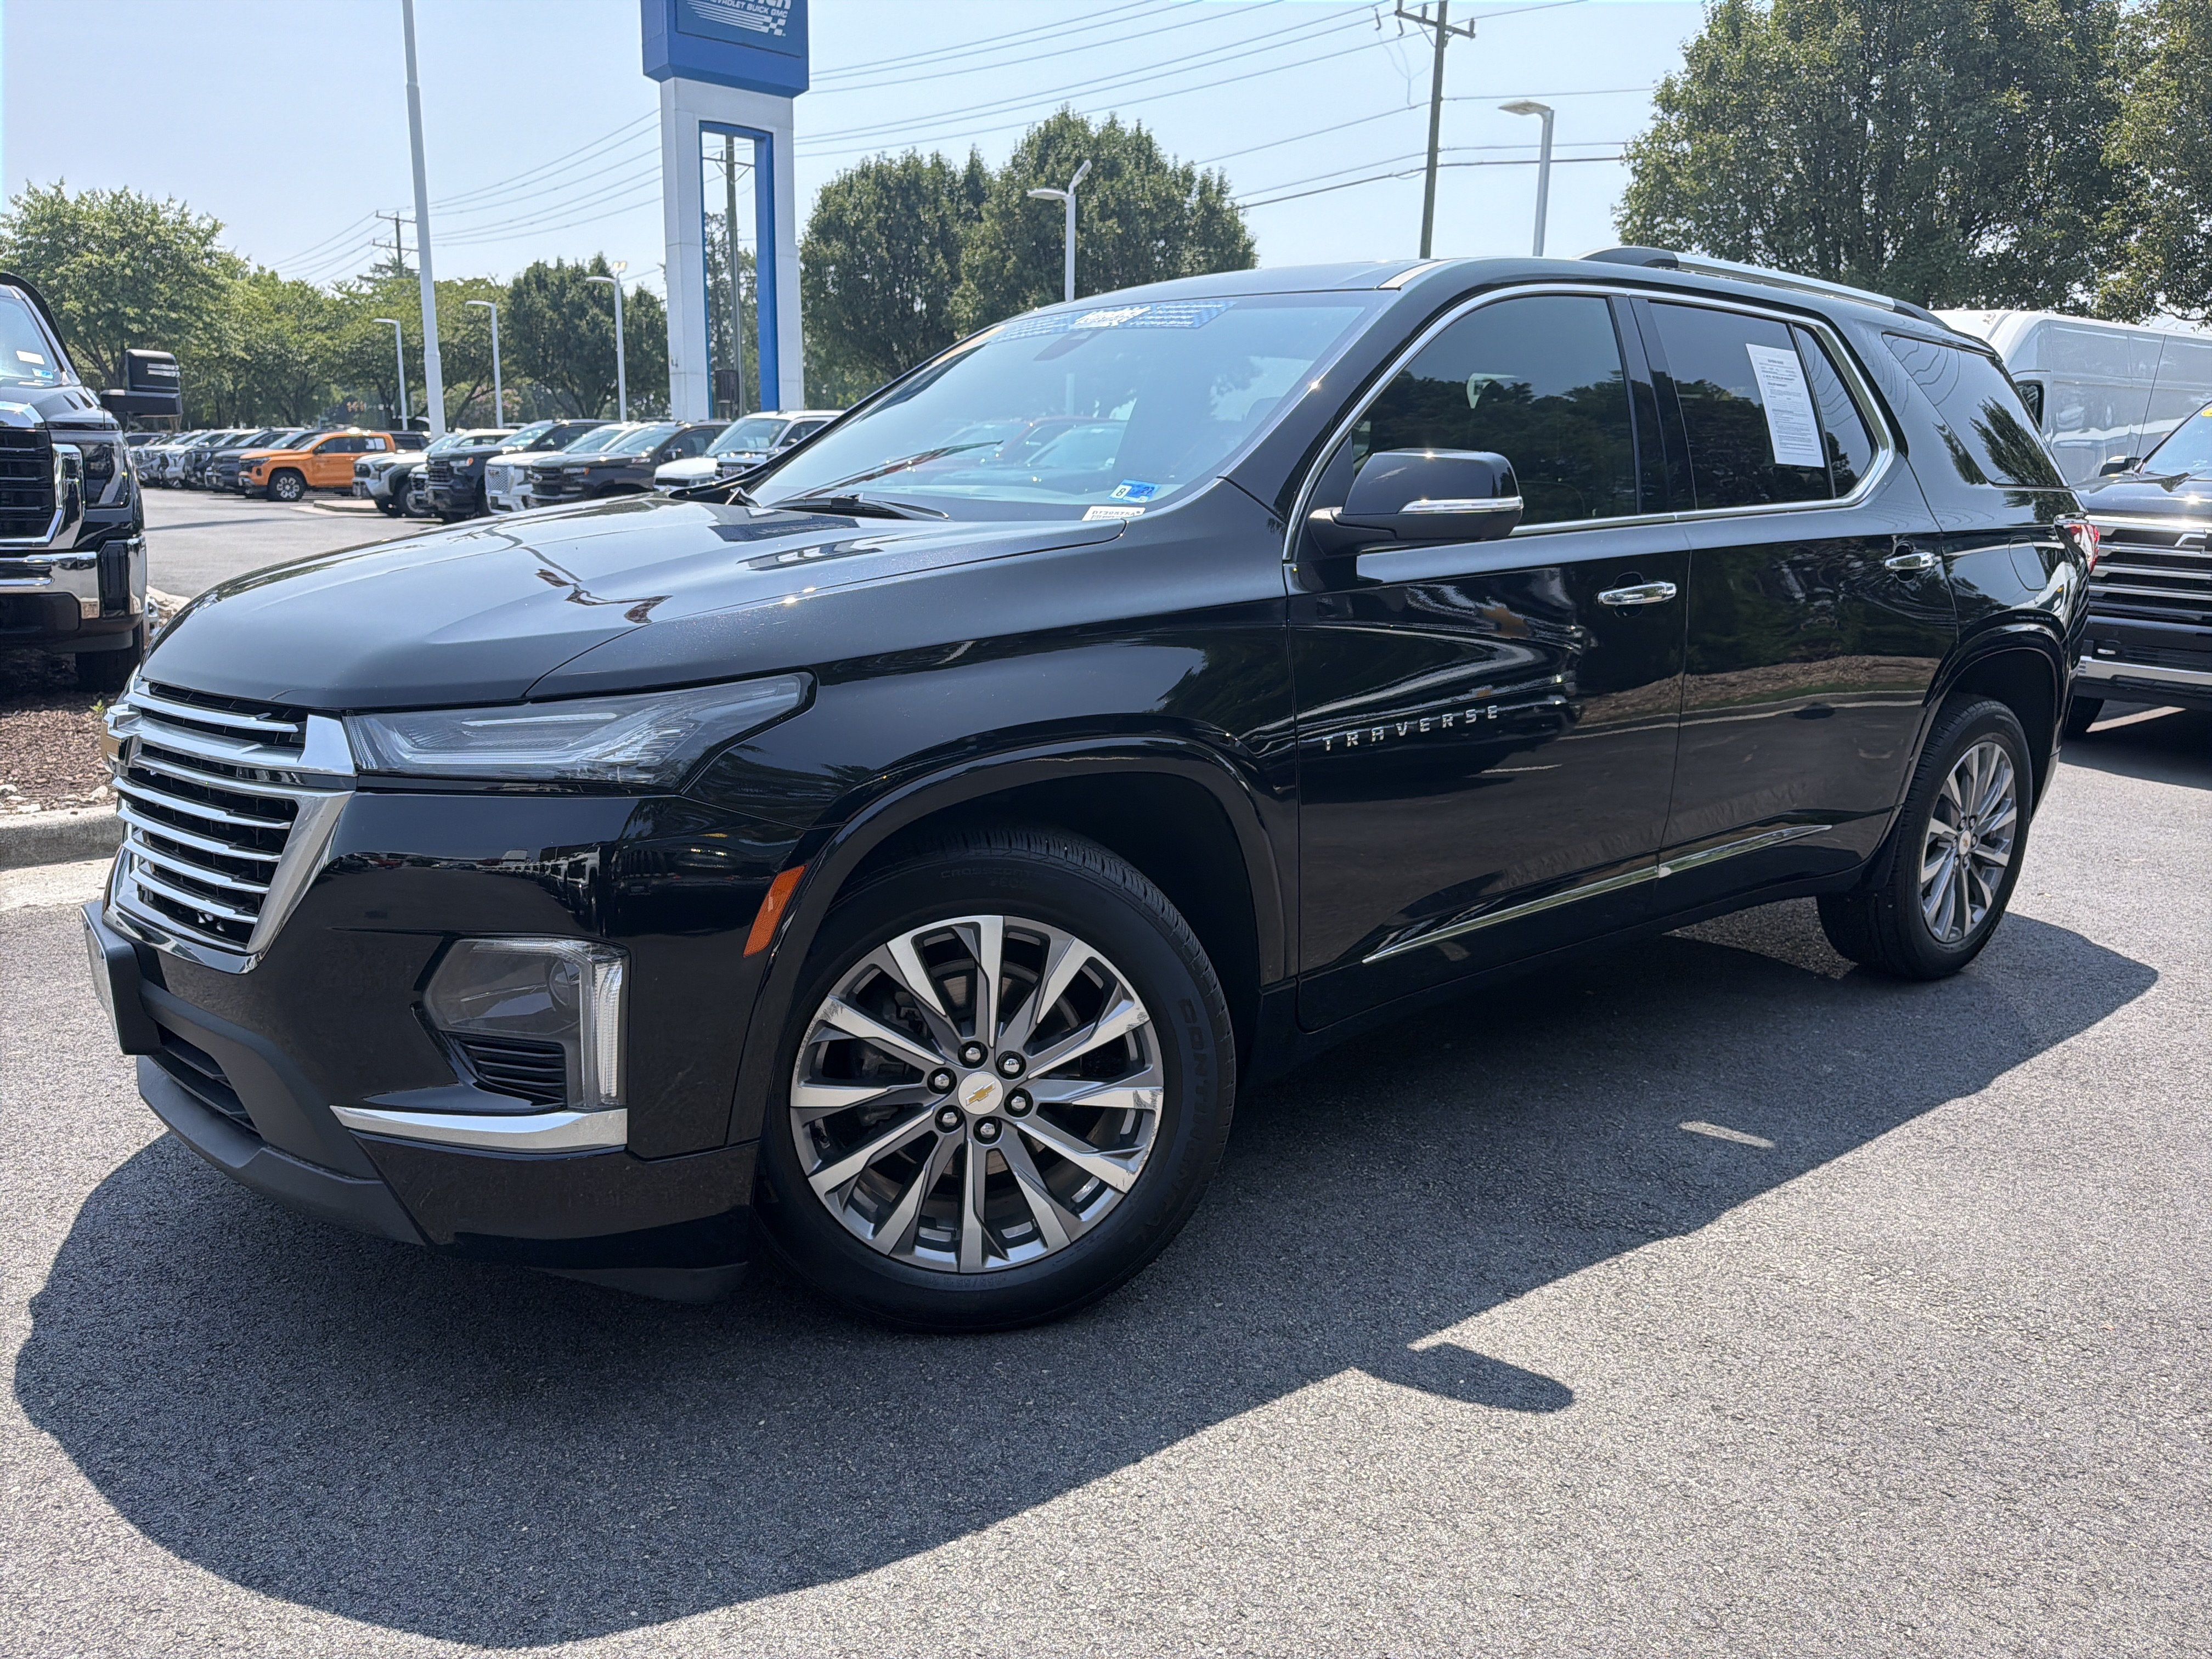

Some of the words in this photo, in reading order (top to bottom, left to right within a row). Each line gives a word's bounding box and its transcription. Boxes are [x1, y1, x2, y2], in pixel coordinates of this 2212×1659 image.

[746, 3, 769, 14] BUICK
[770, 8, 788, 18] GMC
[1116, 488, 1126, 496] 8
[1322, 705, 1498, 751] TRAVERSE
